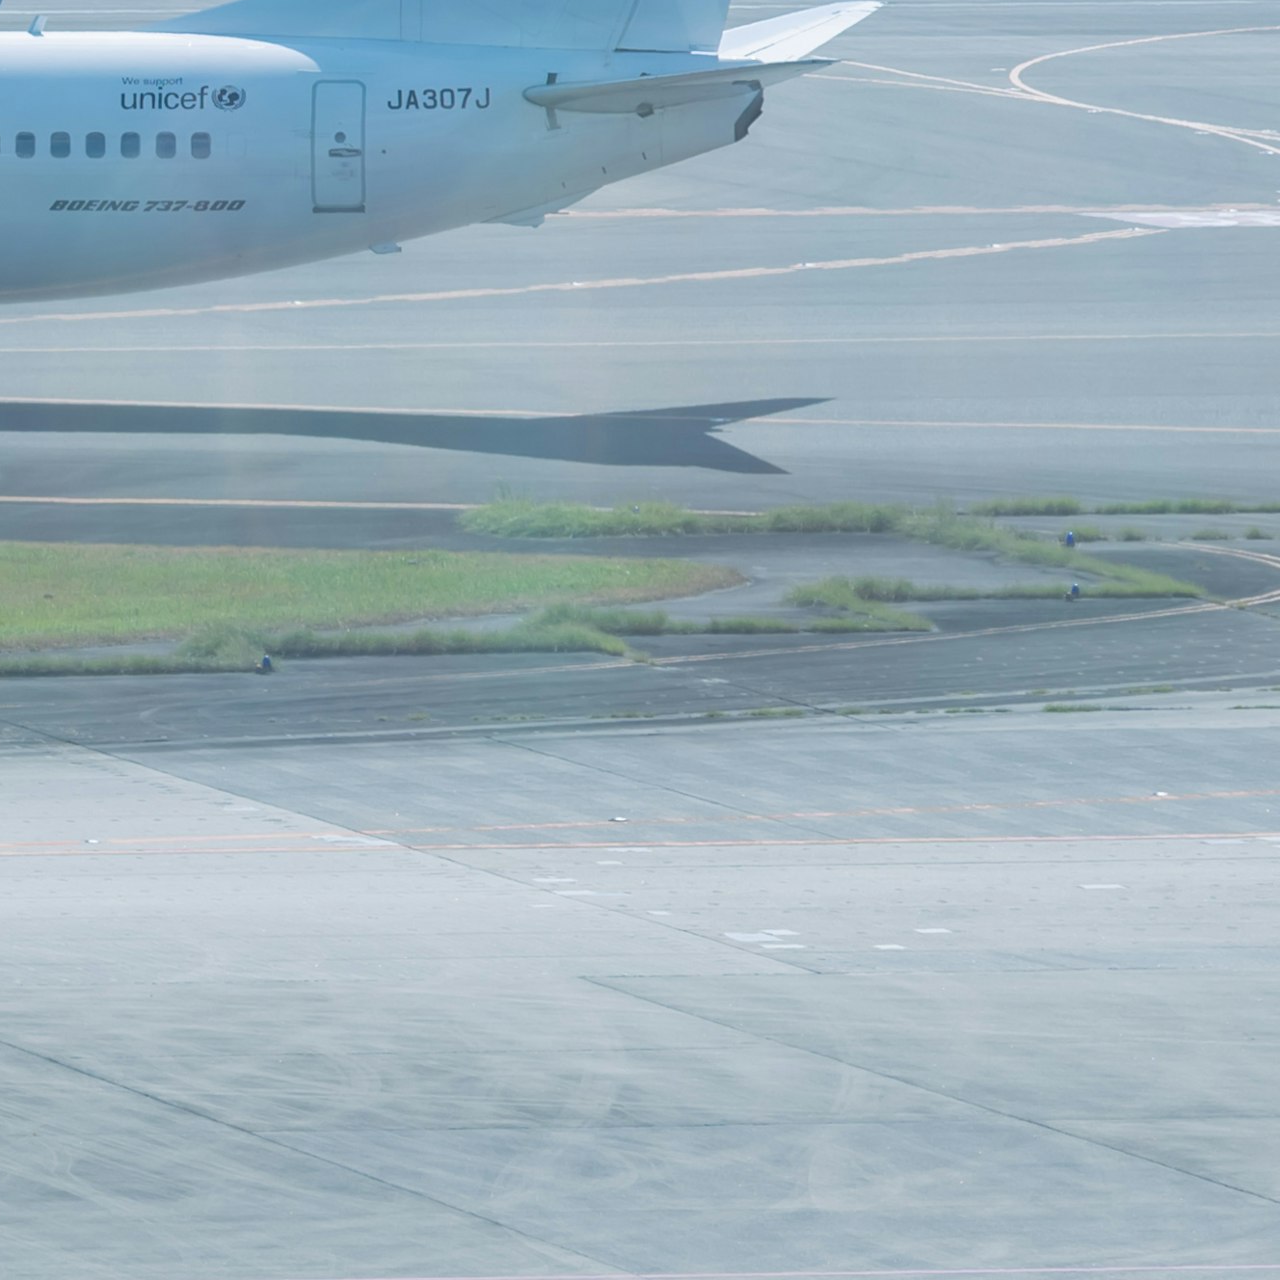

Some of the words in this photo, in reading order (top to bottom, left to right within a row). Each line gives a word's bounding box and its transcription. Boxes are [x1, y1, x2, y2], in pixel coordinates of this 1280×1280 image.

[122, 77, 140, 86] We
[143, 77, 183, 88] support
[121, 85, 208, 110] unicef
[387, 87, 490, 110] JA307J
[49, 199, 140, 212] BOEING
[143, 199, 246, 212] 737-800
